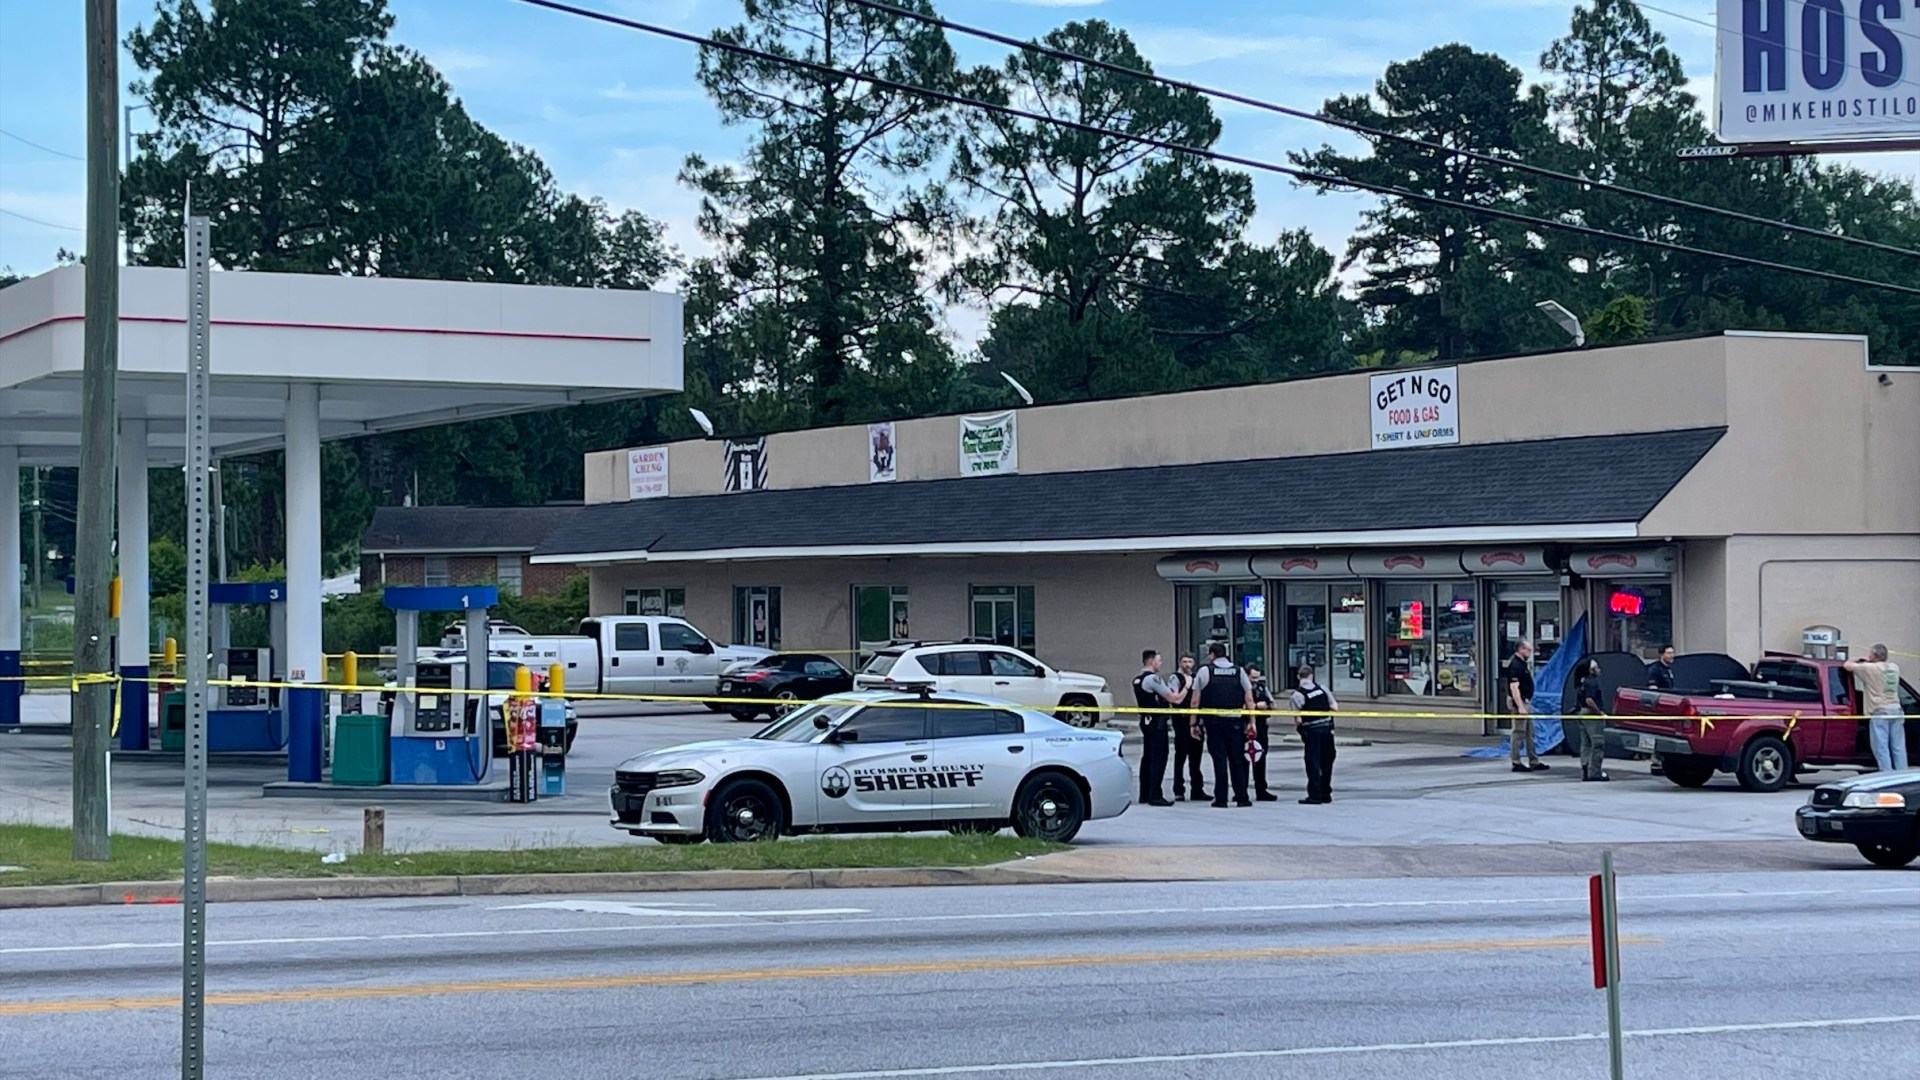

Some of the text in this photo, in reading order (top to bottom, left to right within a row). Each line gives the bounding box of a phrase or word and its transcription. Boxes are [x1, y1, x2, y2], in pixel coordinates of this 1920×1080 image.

[1743, 0, 1920, 92] HOS
[1746, 97, 1916, 123] @MIKEHOSTILO
[1376, 375, 1451, 410] GET N GO
[1388, 405, 1440, 425] FOOD & GAS
[1375, 426, 1455, 442] T-SHIRT & UNIFORMS
[632, 452, 665, 464] GARDEN
[269, 588, 279, 600] 3
[461, 594, 469, 608] 1
[854, 763, 985, 775] RICHMOND COUNTY
[854, 771, 984, 792] SHERIFF
